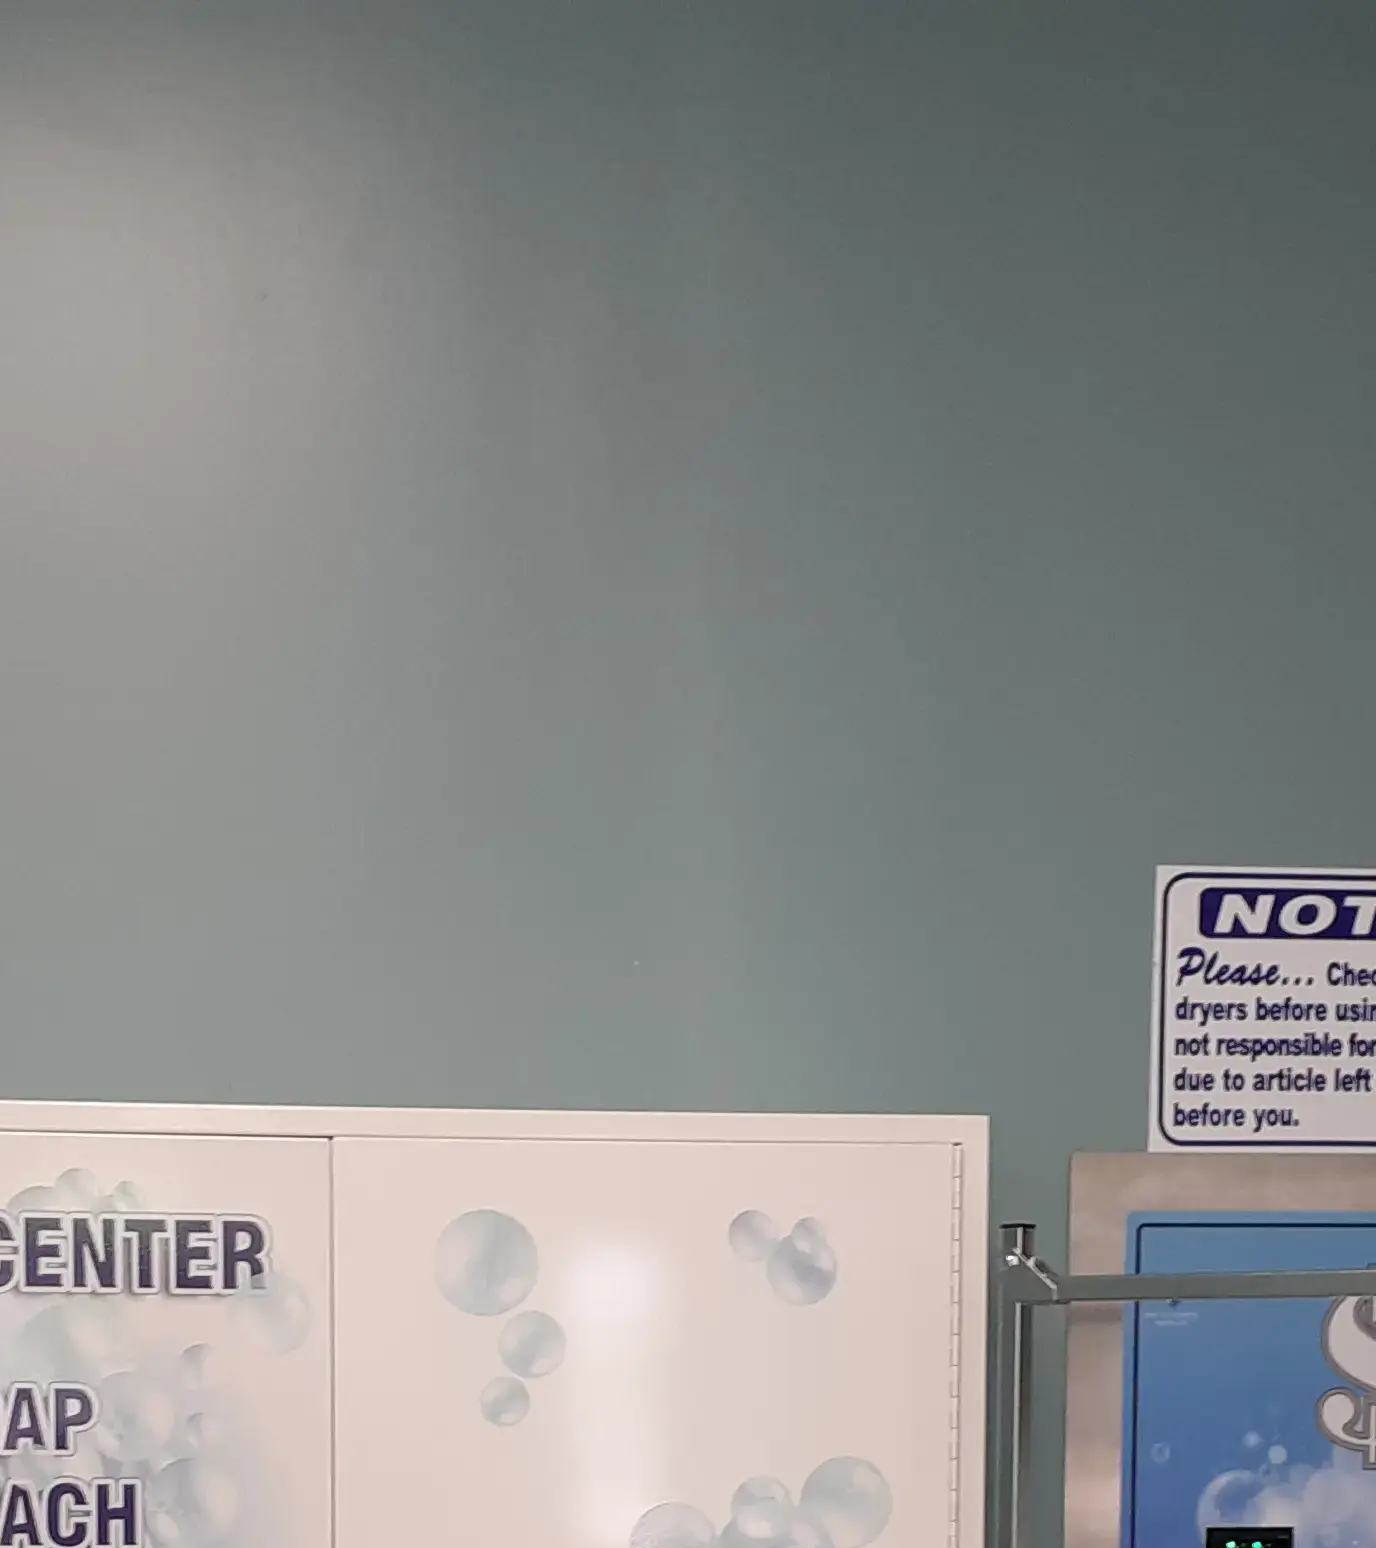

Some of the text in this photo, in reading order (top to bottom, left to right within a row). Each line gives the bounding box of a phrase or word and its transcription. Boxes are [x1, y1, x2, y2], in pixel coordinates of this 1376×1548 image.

[1174, 946, 1315, 988] Please...
[1175, 998, 1248, 1027] dryers
[1256, 997, 1327, 1022] before
[1174, 1036, 1210, 1057] not
[1216, 1033, 1342, 1062] responsible
[1173, 1067, 1214, 1092] due
[1223, 1070, 1245, 1092] to
[1252, 1068, 1326, 1092] article
[1335, 1067, 1370, 1092] left
[1173, 1102, 1299, 1132] before you.
